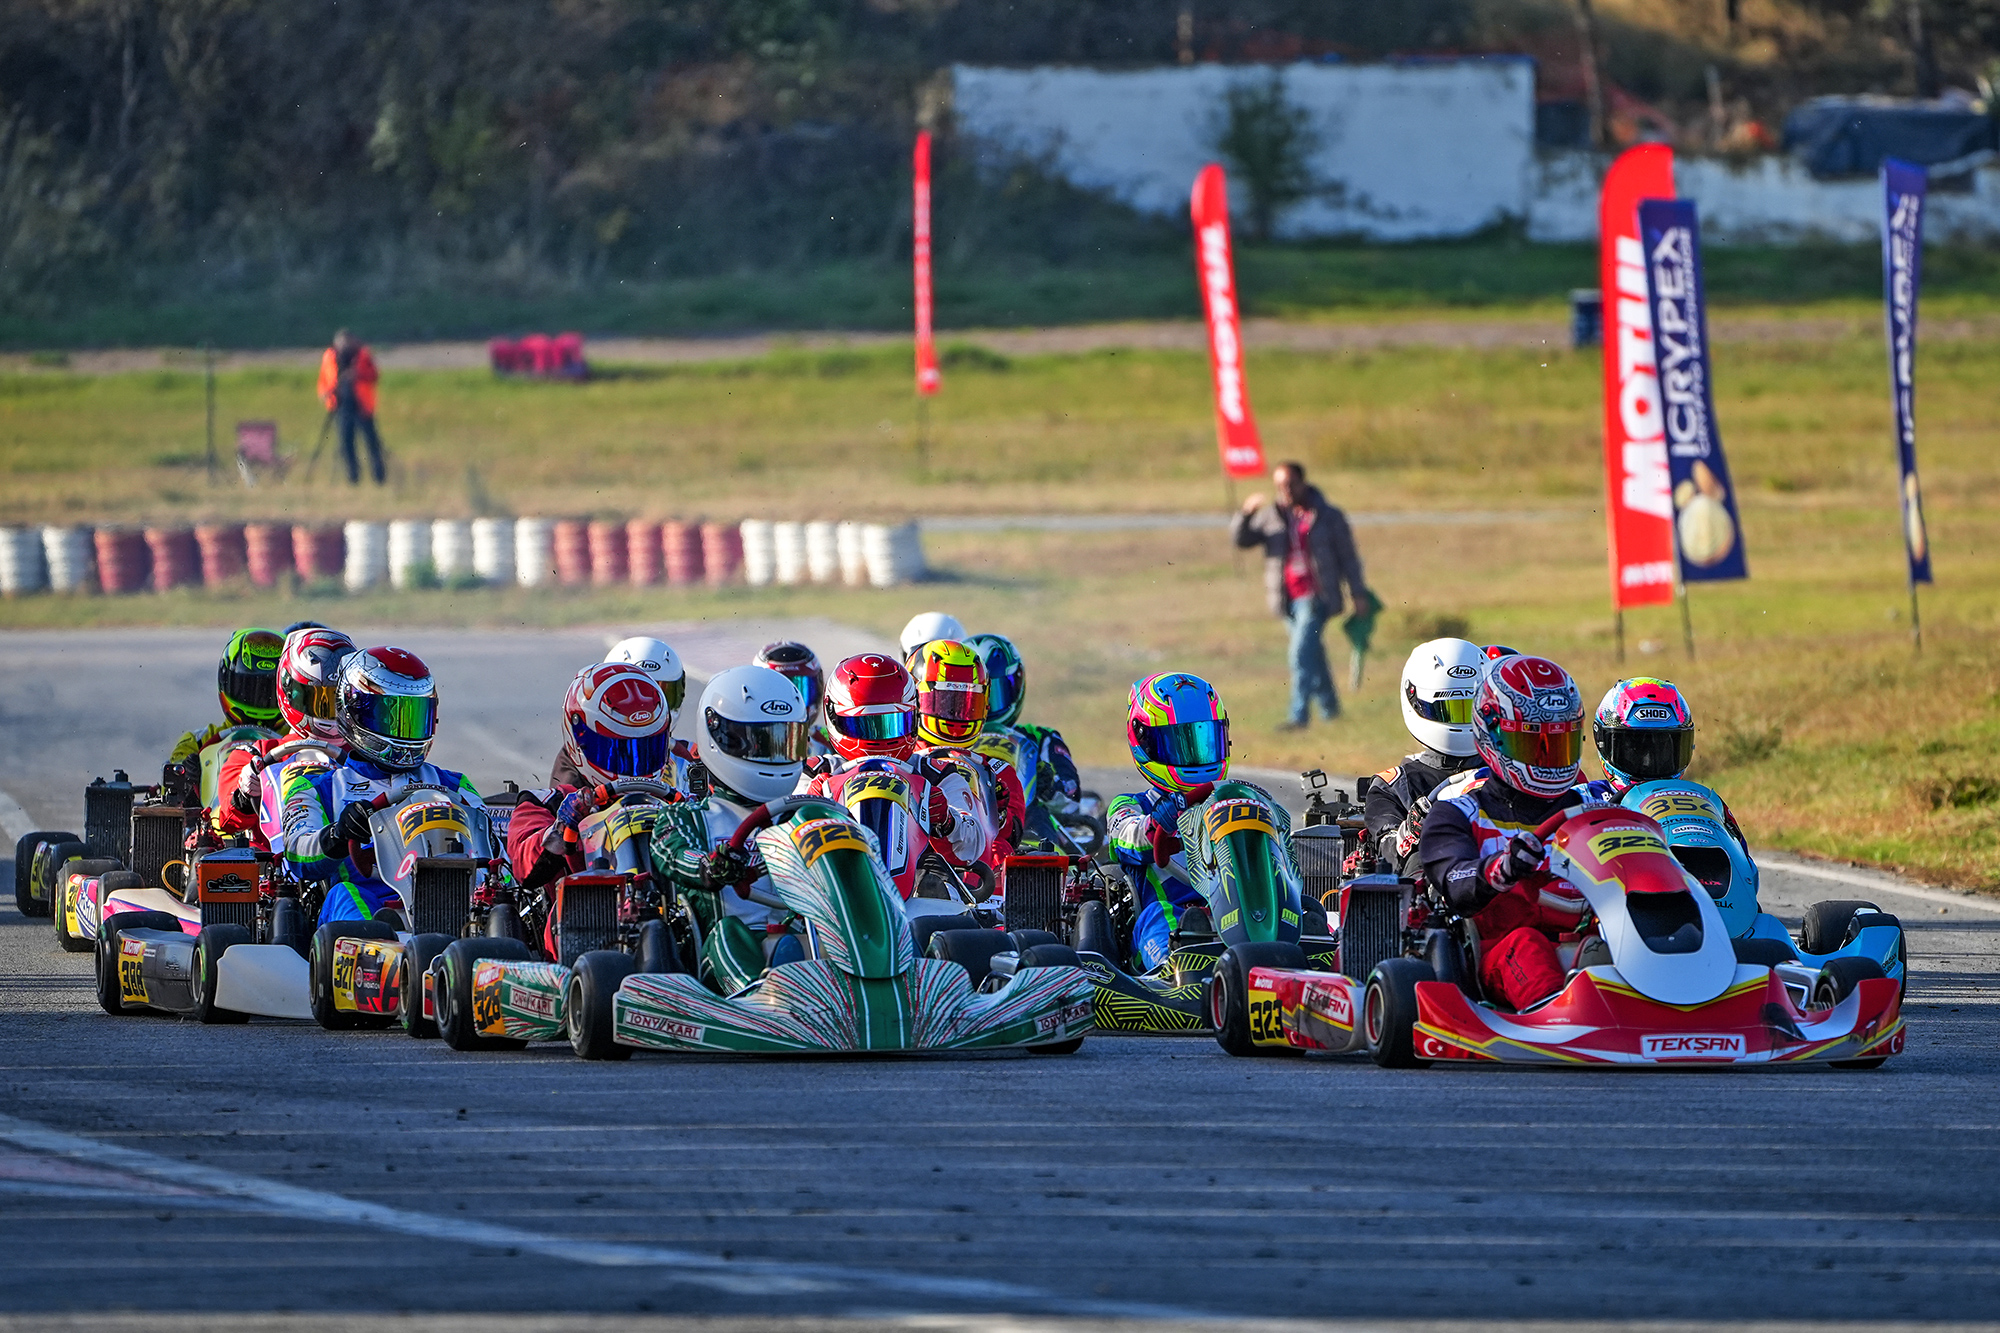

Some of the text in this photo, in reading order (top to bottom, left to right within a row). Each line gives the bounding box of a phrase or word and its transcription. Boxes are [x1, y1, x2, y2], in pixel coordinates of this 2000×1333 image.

[1652, 227, 1698, 457] ICRYPEX
[1449, 666, 1474, 675] Arai
[763, 701, 790, 712] Arai
[1542, 696, 1566, 706] Arai
[630, 712, 650, 722] Arai
[1640, 709, 1667, 719] SHOEI
[854, 771, 902, 780] MOTUL
[1654, 790, 1703, 800] MOTUL
[401, 801, 451, 820] MOTUL
[1214, 798, 1269, 811] MOTUL
[612, 808, 658, 836] 32
[799, 819, 853, 836] MOTUL
[1660, 817, 1706, 828] orusan
[1602, 825, 1648, 834] MOTUL
[1598, 836, 1669, 858] 323
[1254, 977, 1274, 989] MOTUL
[474, 980, 502, 1031] 328
[628, 1010, 701, 1038] TONY KART
[1250, 999, 1285, 1040] 323
[1646, 1037, 1740, 1055] TEKŞAN
